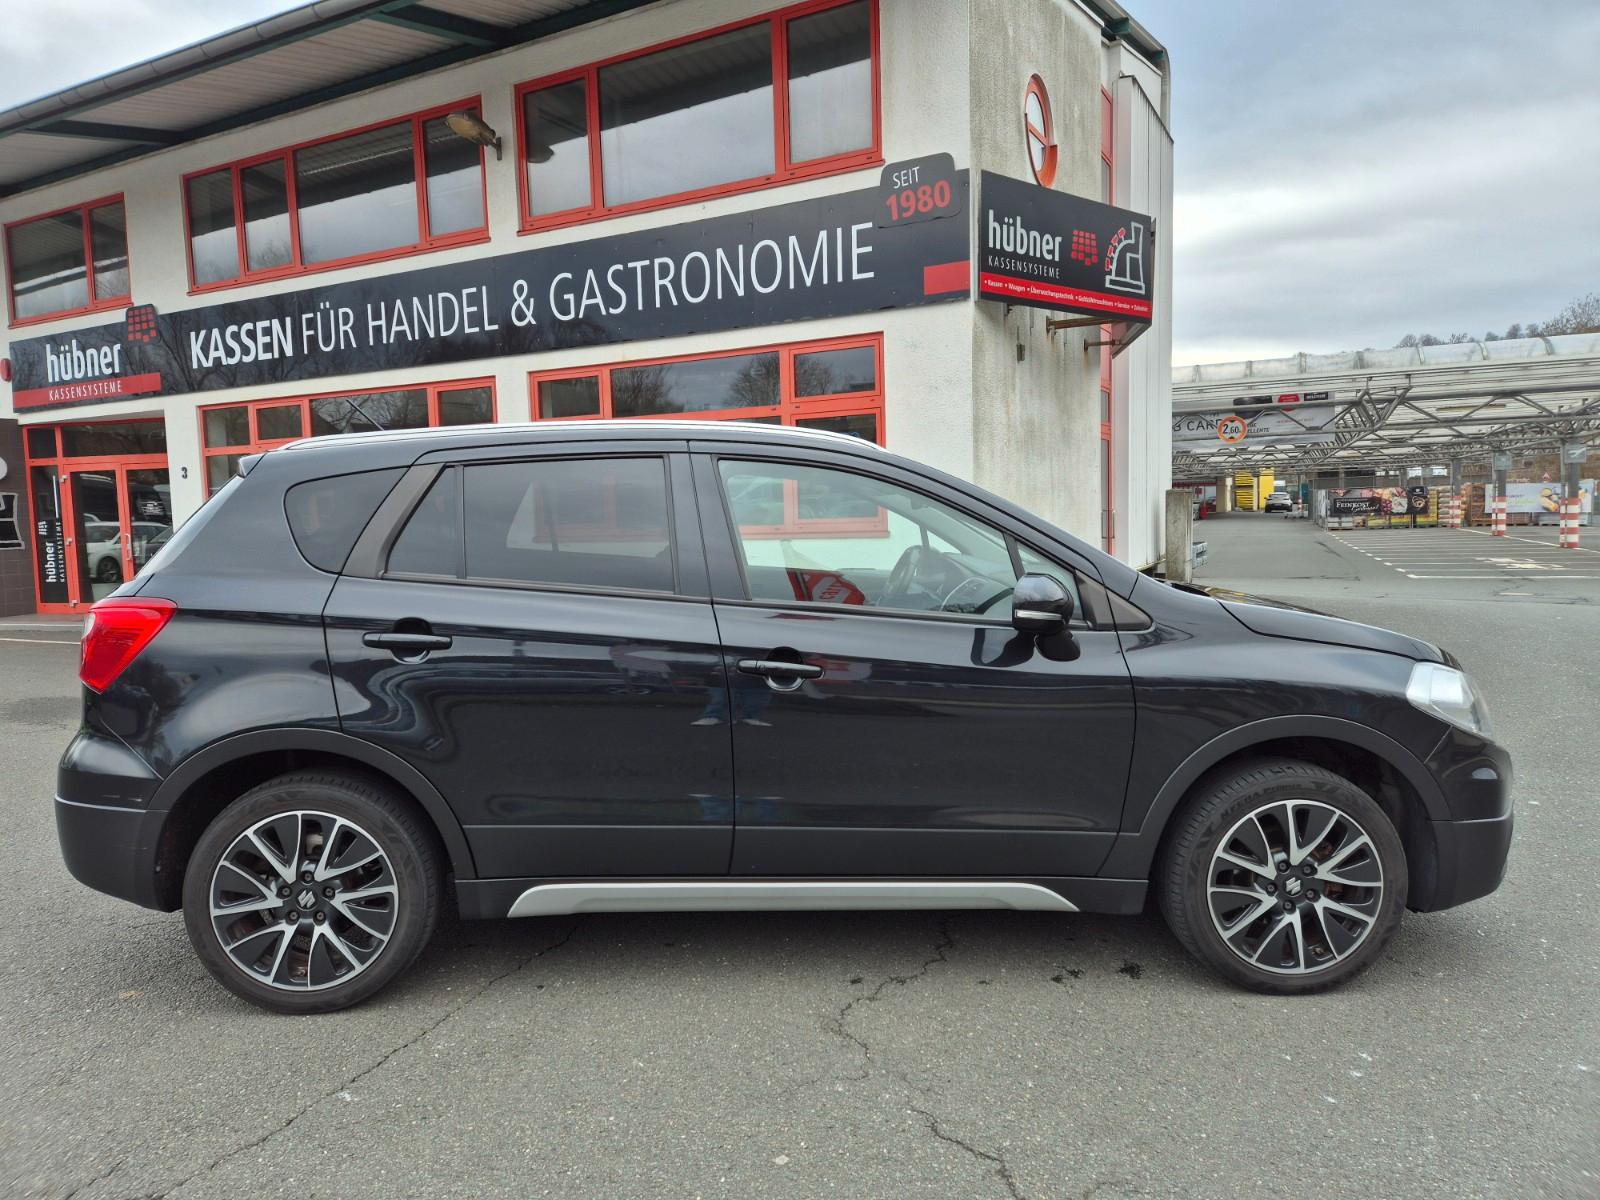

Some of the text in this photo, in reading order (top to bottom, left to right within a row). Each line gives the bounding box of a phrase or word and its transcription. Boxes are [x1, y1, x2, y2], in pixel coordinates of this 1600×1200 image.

[892, 166, 920, 189] SEIT
[885, 180, 951, 222] 1980
[988, 209, 1062, 262] hübner
[988, 255, 1060, 279] KASSENSYSTEME
[190, 222, 876, 370] KASSEN FÜR HANDEL & GASTRONOMIE
[45, 339, 122, 384] hübner
[48, 380, 122, 402] KASSENSYSTEME
[181, 466, 188, 479] 3
[44, 541, 57, 583] hübner
[55, 522, 65, 583] KASSENSYSTEME
